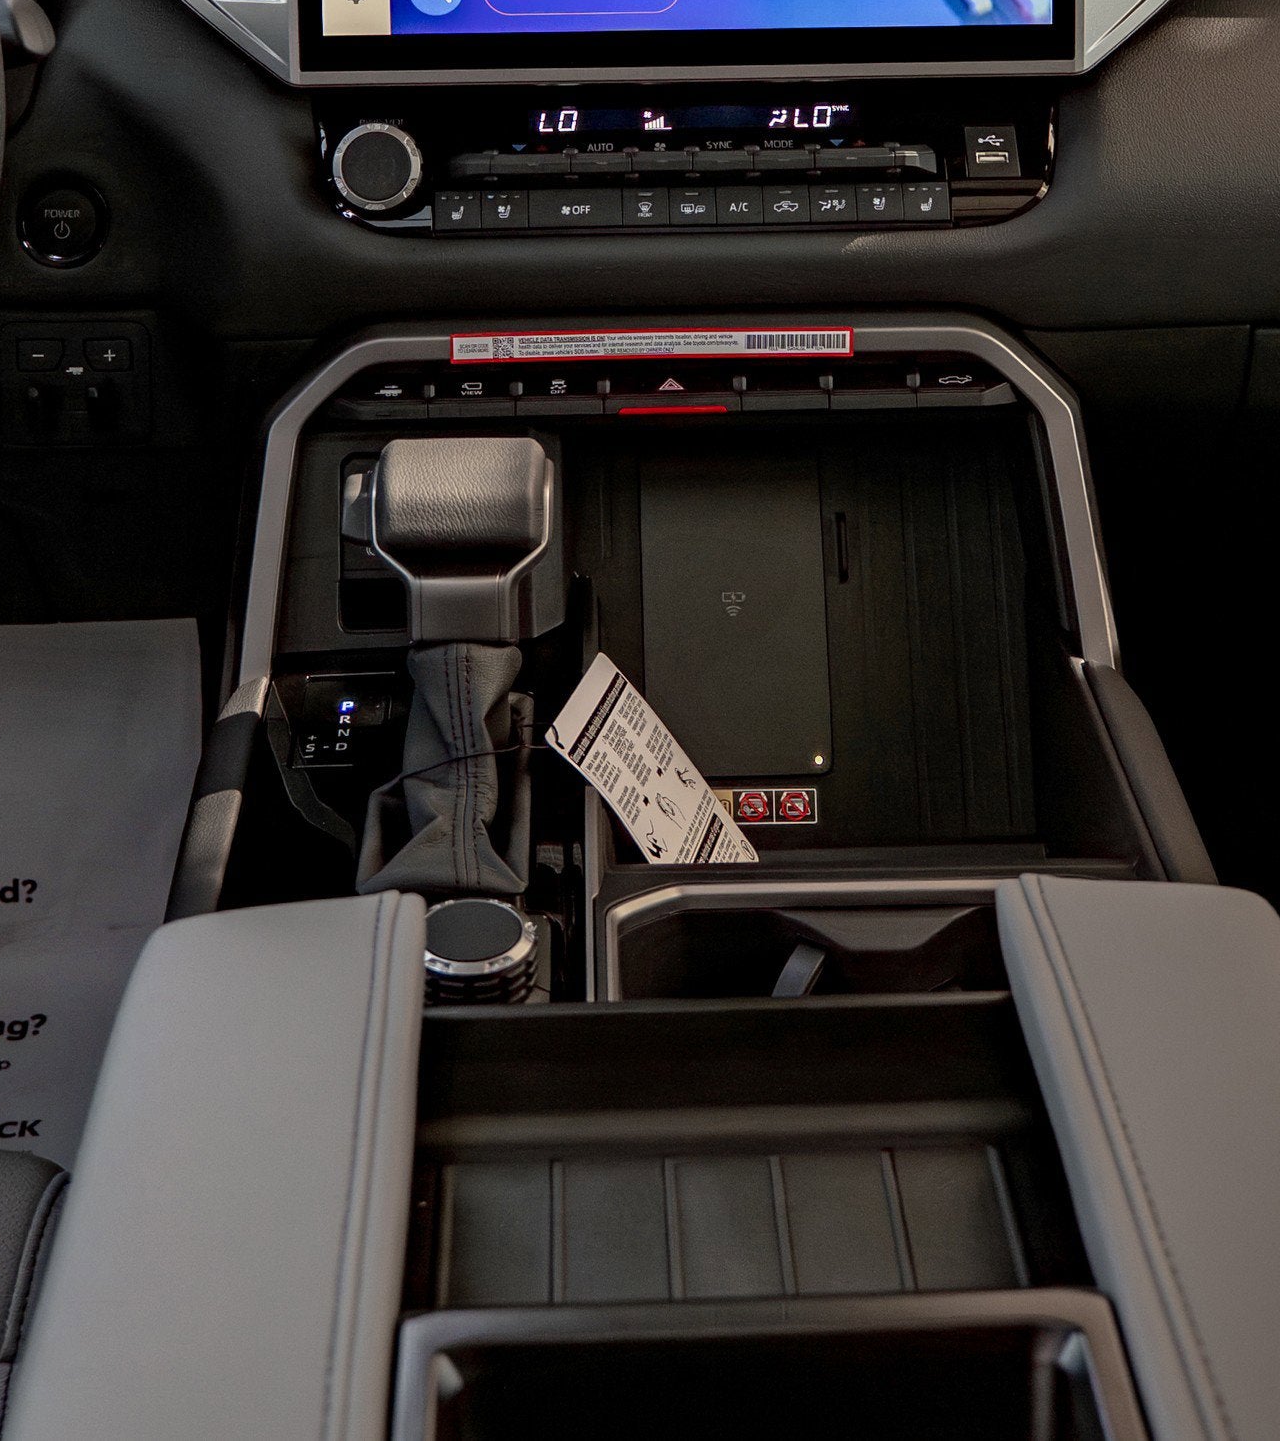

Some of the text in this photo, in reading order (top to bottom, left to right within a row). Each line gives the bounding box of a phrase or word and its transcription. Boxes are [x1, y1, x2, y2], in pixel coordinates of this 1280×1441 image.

[537, 109, 579, 133] LO
[793, 105, 832, 130] LO
[586, 141, 615, 154] AUTO
[705, 139, 734, 151] SYNC
[763, 138, 796, 150] MODE
[571, 204, 592, 216] OFF
[728, 200, 750, 214] A/C
[43, 208, 81, 219] POWER
[459, 389, 484, 397] VIEW
[549, 388, 567, 397] OFF
[341, 700, 355, 712] P
[339, 714, 352, 725] R
[337, 728, 350, 738] N
[305, 742, 348, 753] S D
